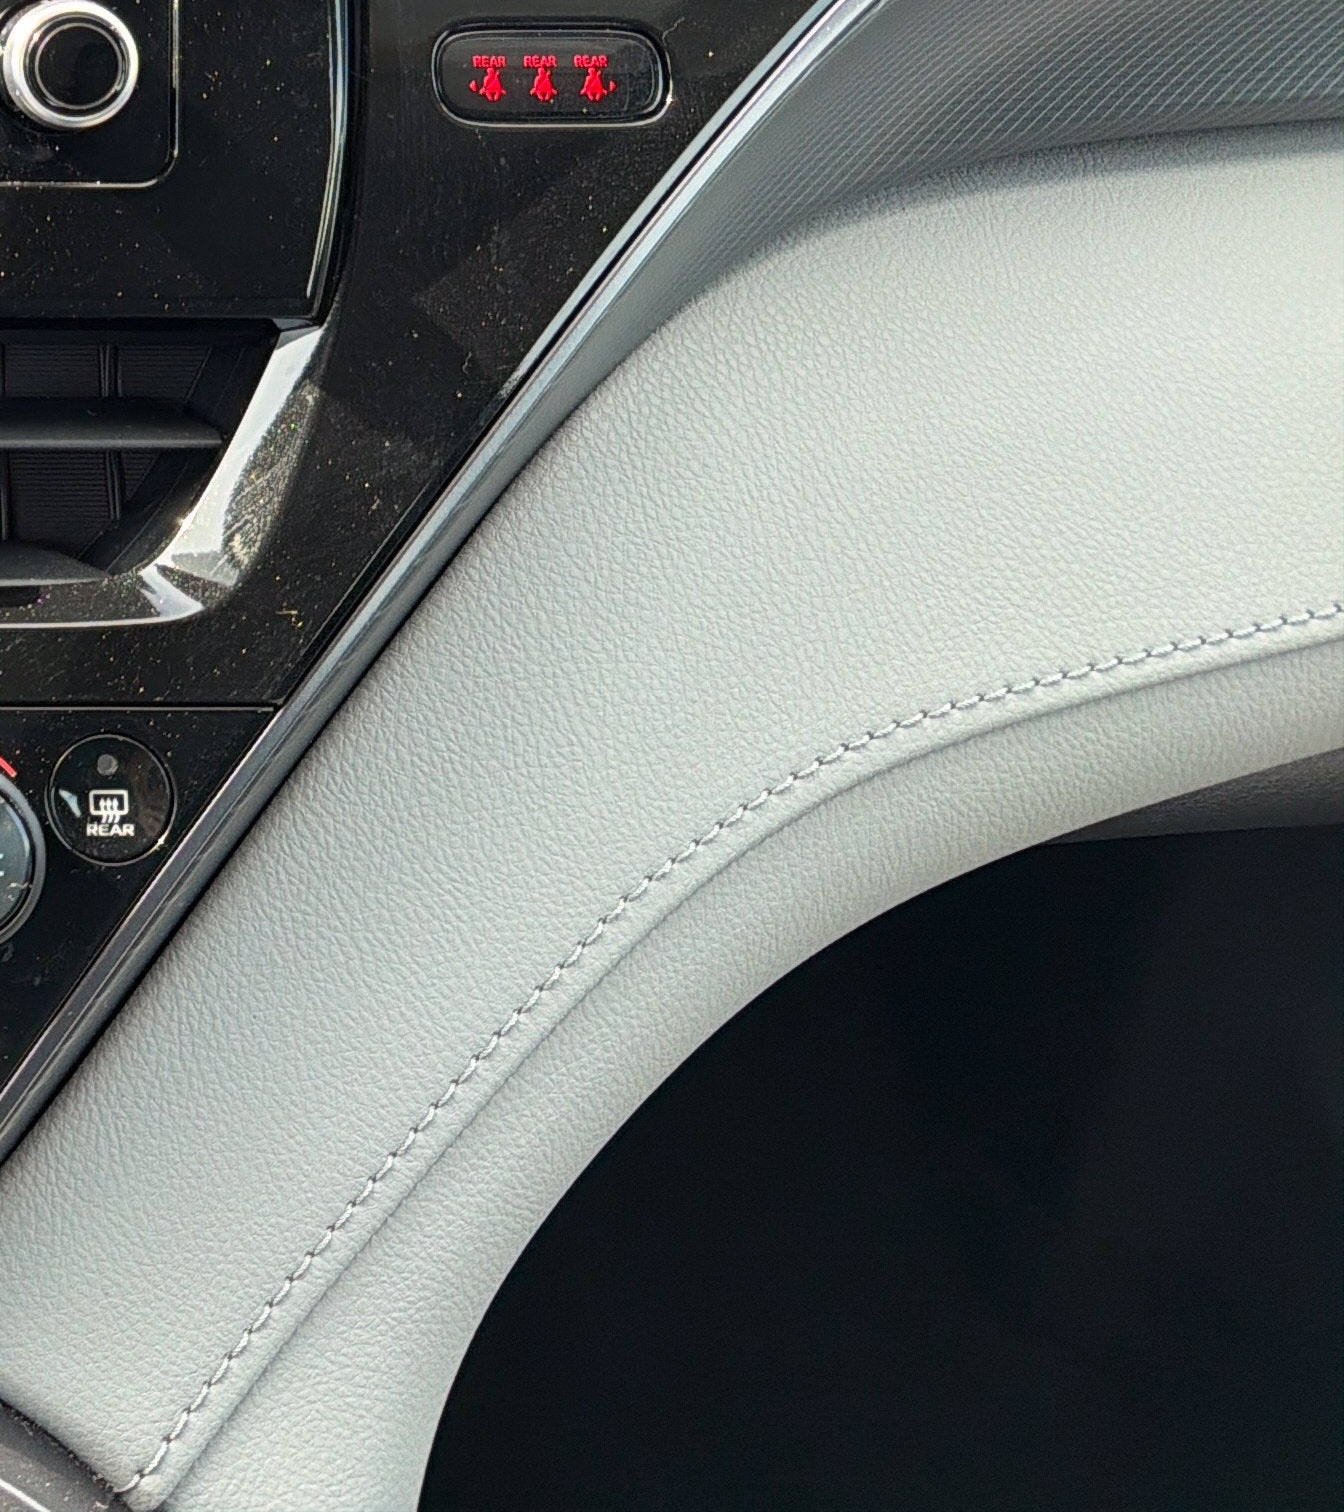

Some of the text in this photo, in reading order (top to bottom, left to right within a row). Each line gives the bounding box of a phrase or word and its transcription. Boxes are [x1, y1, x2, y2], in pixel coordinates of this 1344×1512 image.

[472, 55, 507, 68] REAR
[523, 55, 558, 68] REAR
[573, 55, 609, 68] REAR
[86, 822, 136, 838] REAR
